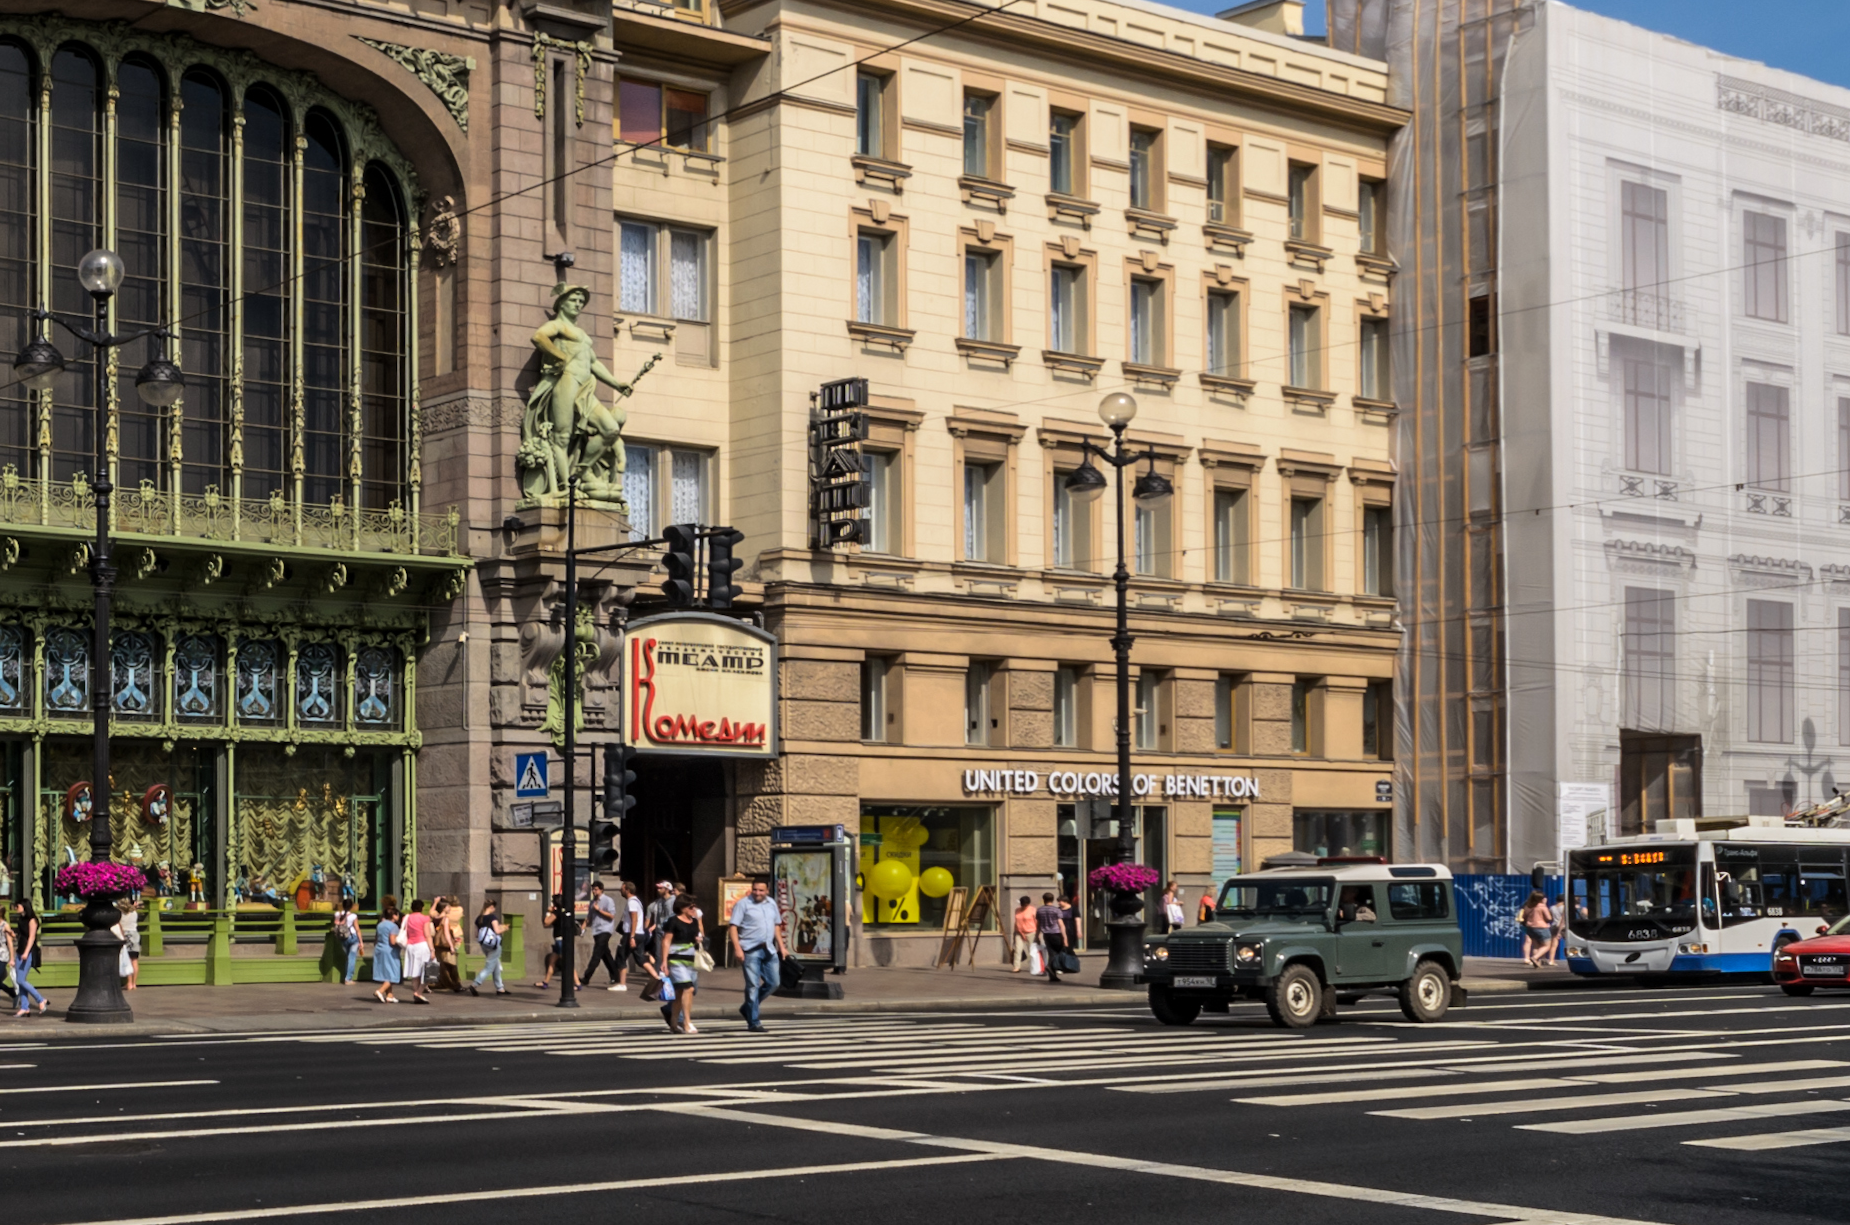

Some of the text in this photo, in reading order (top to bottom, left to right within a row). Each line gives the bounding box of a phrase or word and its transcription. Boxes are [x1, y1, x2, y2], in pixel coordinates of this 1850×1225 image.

[657, 651, 764, 669] ТЕАТР
[965, 769, 1039, 792] UNITED
[1048, 771, 1120, 794] COLORS
[1132, 773, 1157, 795] OF
[1767, 907, 1783, 916] 6838
[1627, 929, 1659, 940] 6838
